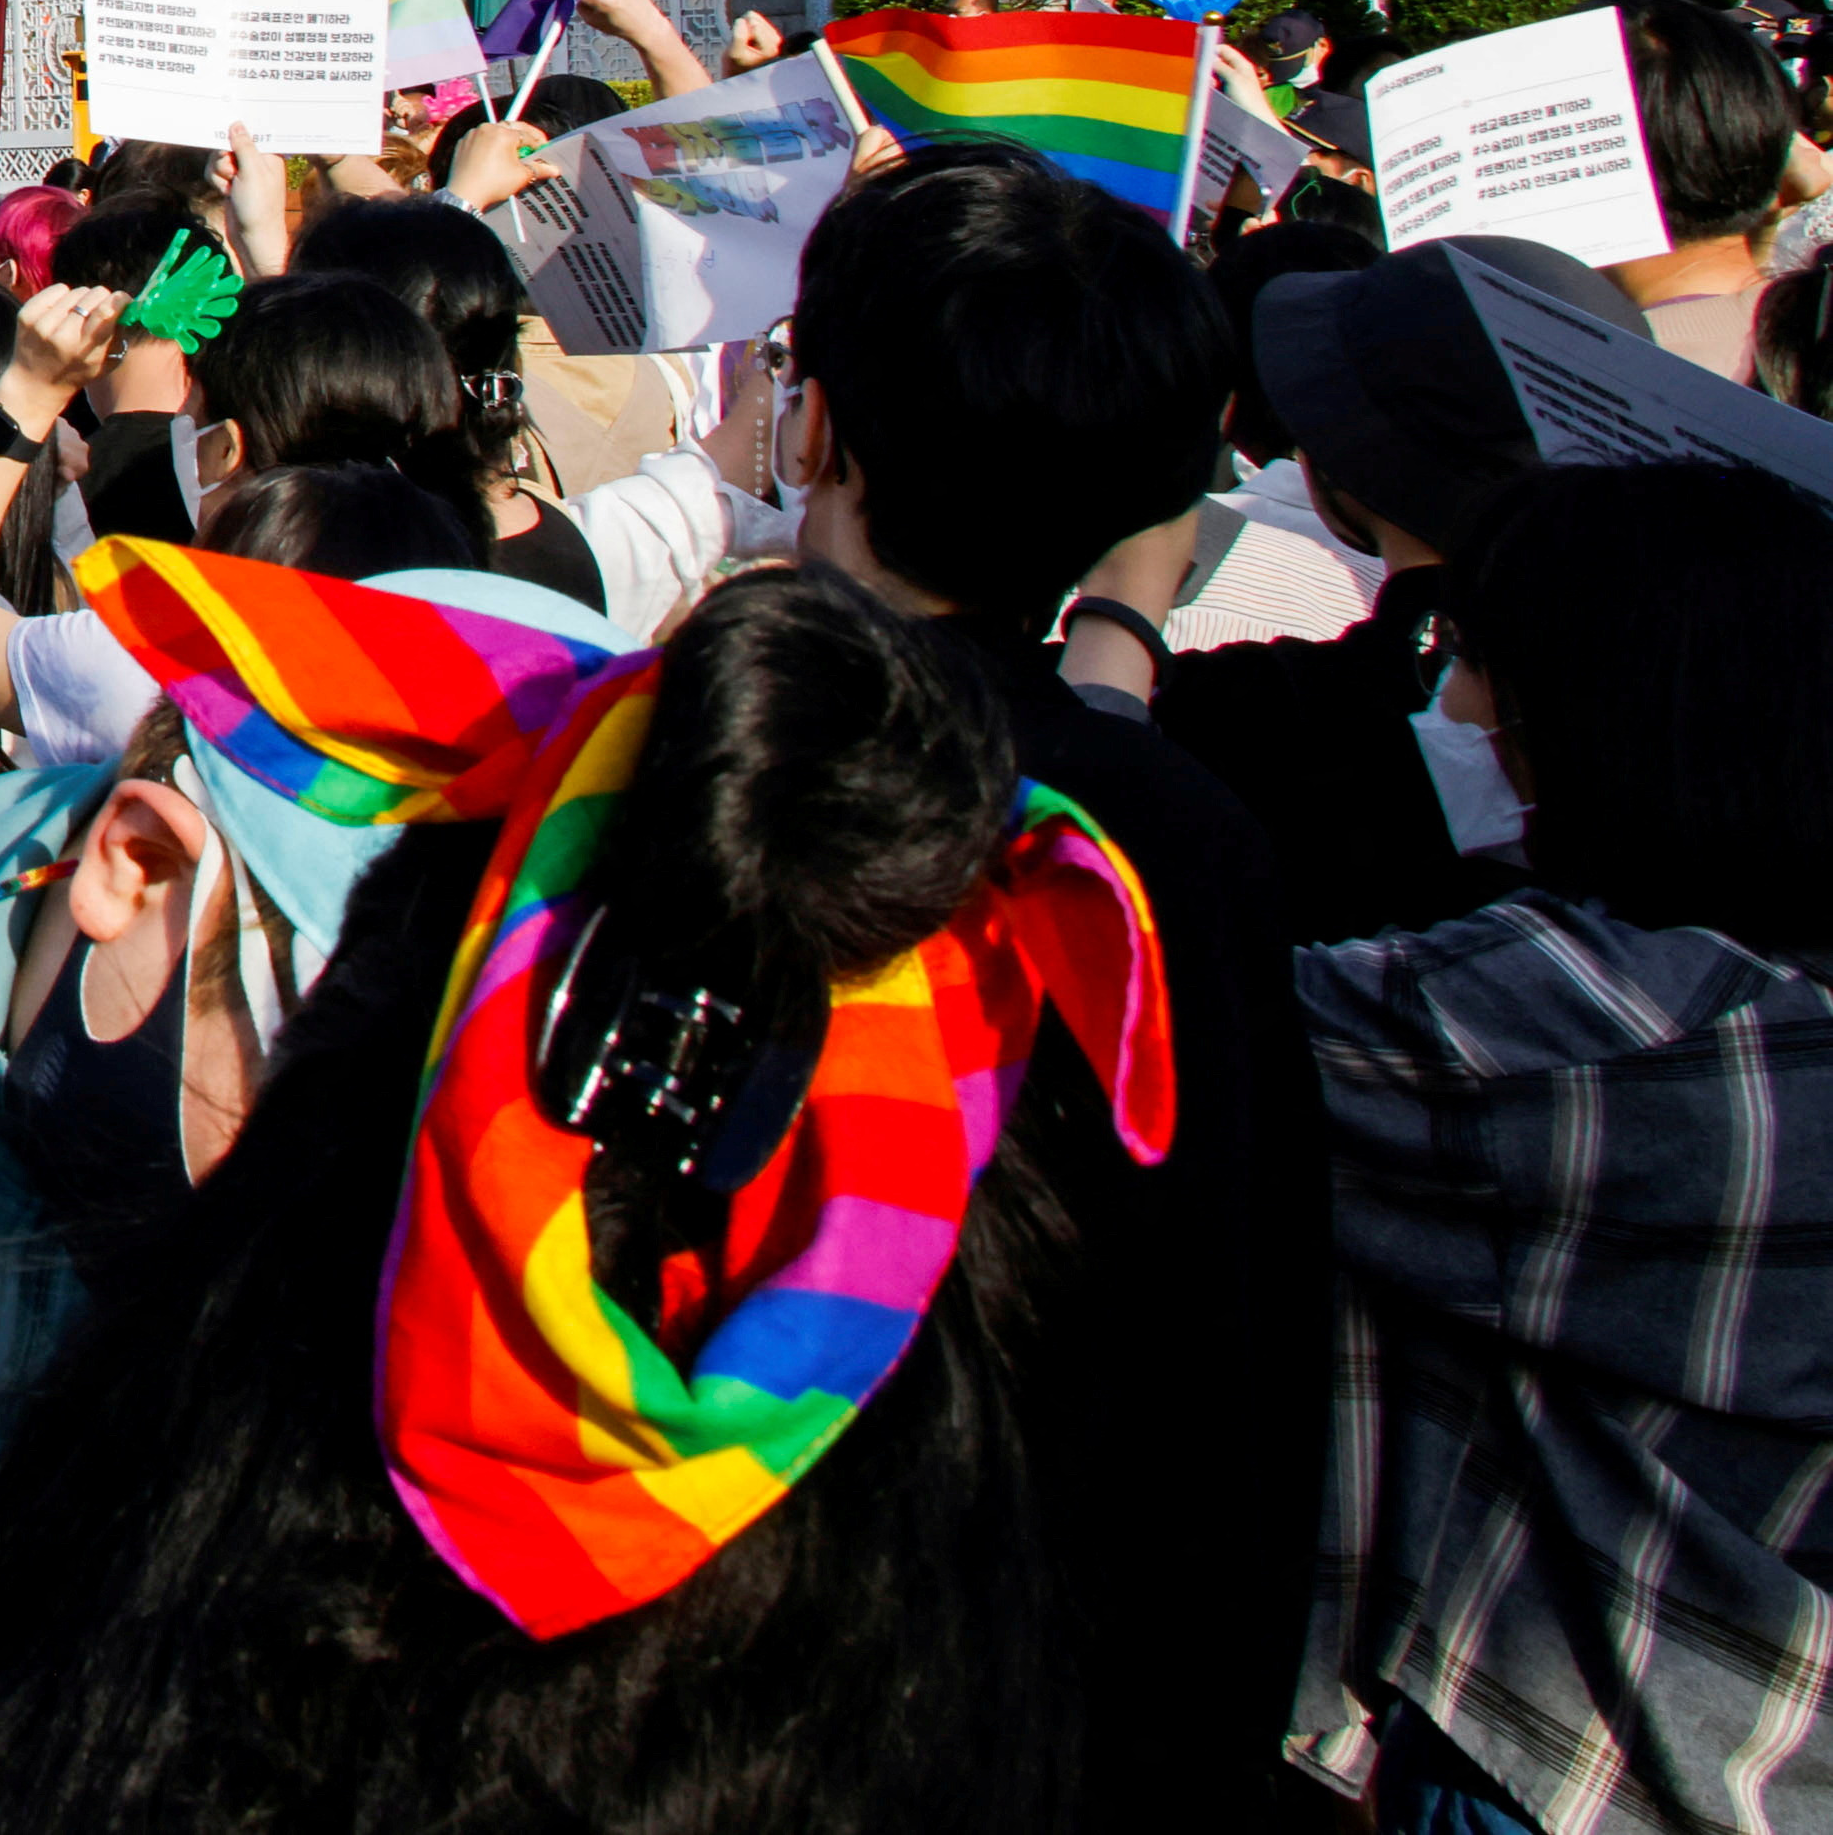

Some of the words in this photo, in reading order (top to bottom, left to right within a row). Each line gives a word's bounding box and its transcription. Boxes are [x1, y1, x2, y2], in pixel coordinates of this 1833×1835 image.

[156, 3, 197, 18] 제정하라
[231, 12, 304, 24] #성교육표준안
[306, 13, 351, 25] 폐기하라
[230, 31, 282, 43] #수술없이
[284, 32, 328, 43] 성별정정
[330, 32, 374, 44] 보장하라
[168, 42, 208, 56] 폐지하라
[229, 50, 281, 61] #트랜지션
[284, 51, 327, 62] 건강보험
[330, 51, 373, 63] 보장하라
[156, 60, 195, 75] 보장하라
[229, 68, 280, 80] #성소수자
[283, 69, 326, 81] 인권교육
[329, 70, 373, 82] 실시하라
[1469, 109, 1543, 135] #성교육표준안
[1544, 97, 1592, 116] 폐기하라
[1472, 134, 1524, 157] #수술없이
[1527, 124, 1572, 145] 성별정정
[1575, 113, 1623, 134] 보장하라
[1475, 157, 1528, 179] #트랜지션
[1530, 146, 1577, 167] 건강보험
[1579, 135, 1627, 156] 보장하라
[1477, 178, 1531, 200] #성소수자
[1533, 167, 1581, 188] 인권교육
[1585, 157, 1632, 178] 실시하라
